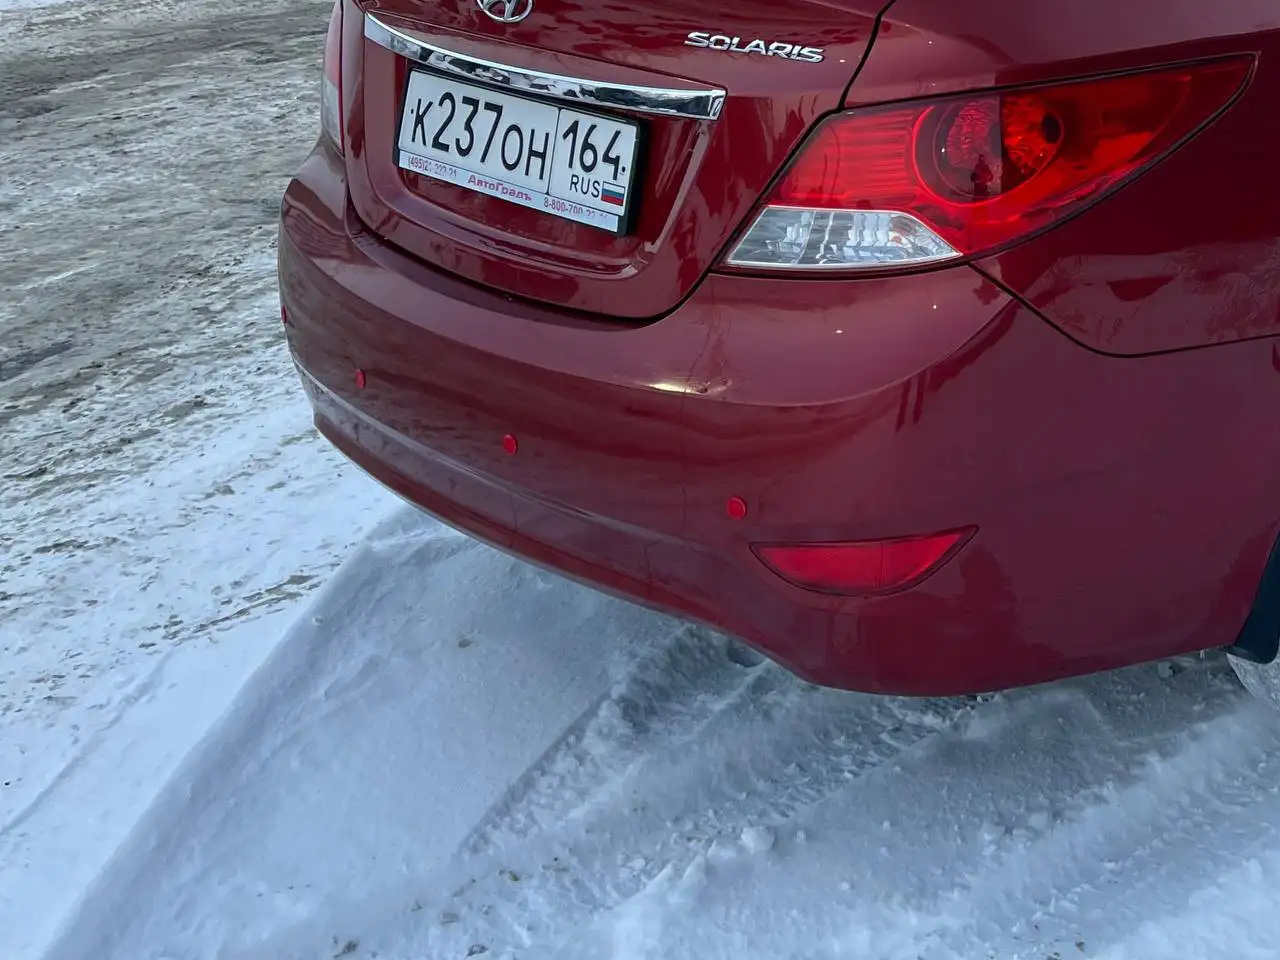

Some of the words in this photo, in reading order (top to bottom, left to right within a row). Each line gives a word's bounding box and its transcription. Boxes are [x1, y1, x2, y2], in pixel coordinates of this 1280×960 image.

[683, 31, 825, 63] SOLARIS
[562, 120, 621, 180] 164
[569, 173, 600, 198] RUS
